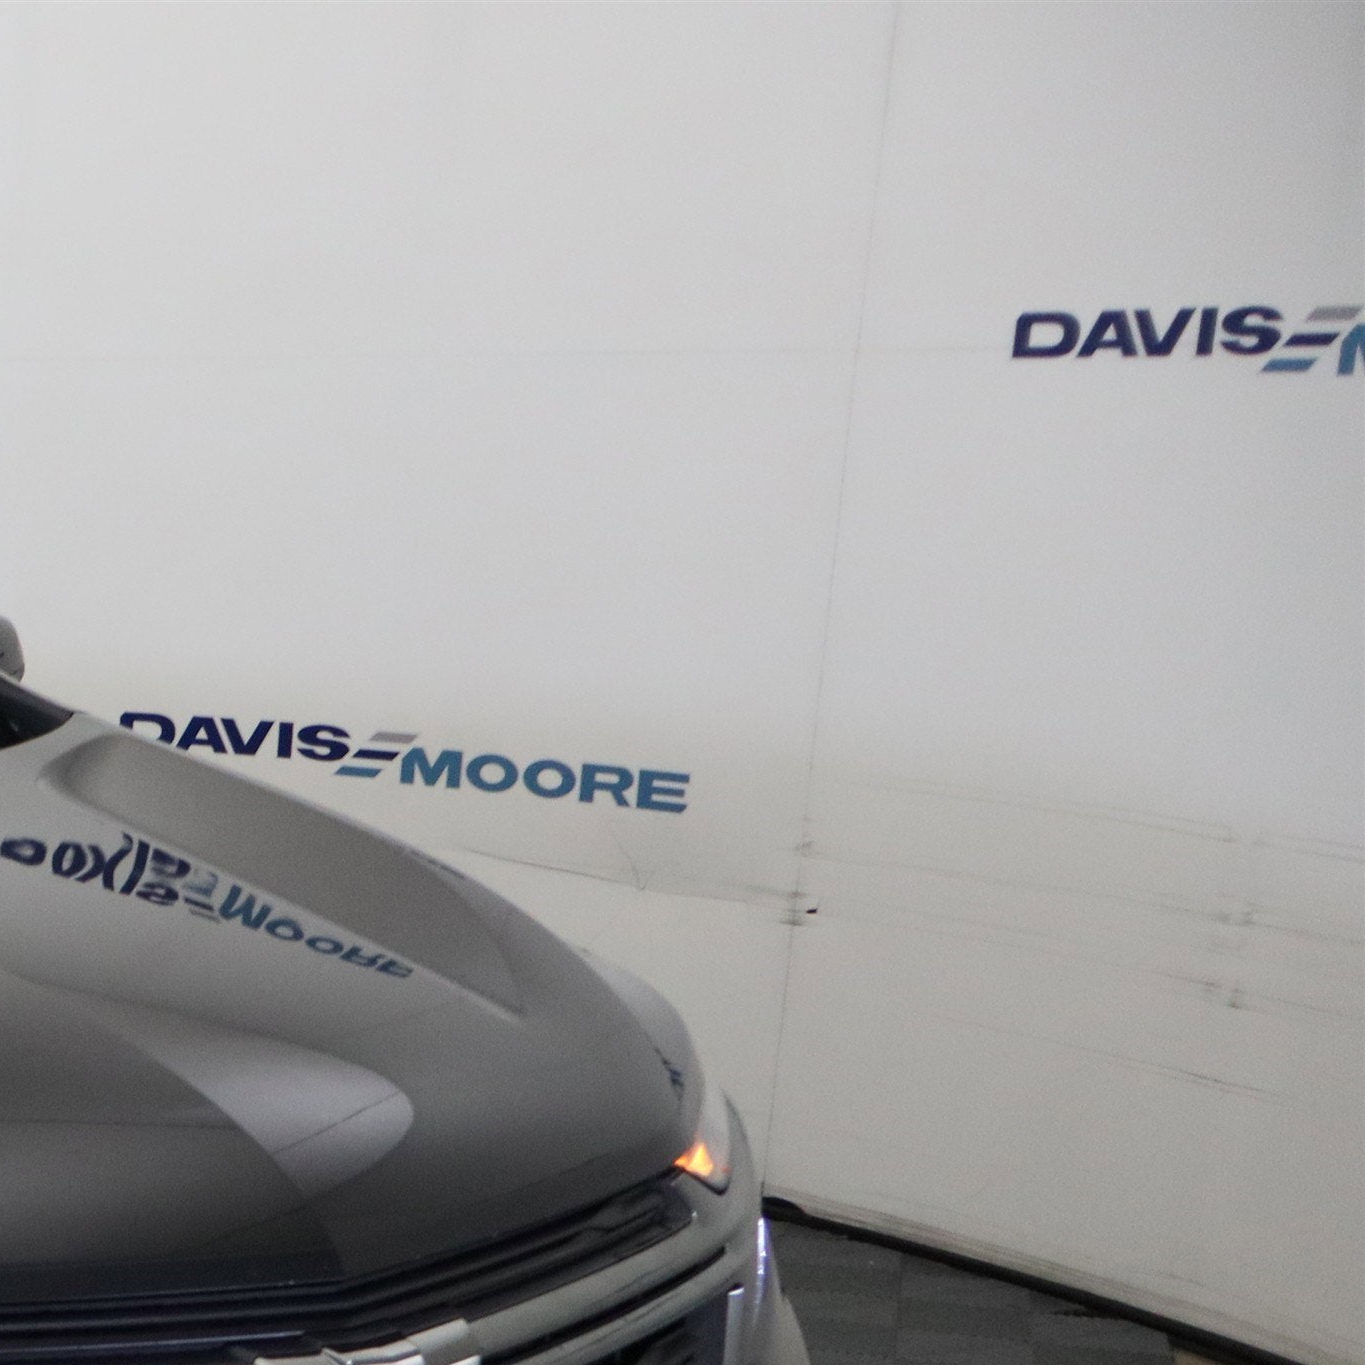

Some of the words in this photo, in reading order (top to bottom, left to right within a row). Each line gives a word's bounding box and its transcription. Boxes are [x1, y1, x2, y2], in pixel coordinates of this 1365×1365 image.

[1012, 305, 1283, 358] DAVIS
[119, 711, 351, 761] DAVIS
[400, 747, 691, 813] MOORE
